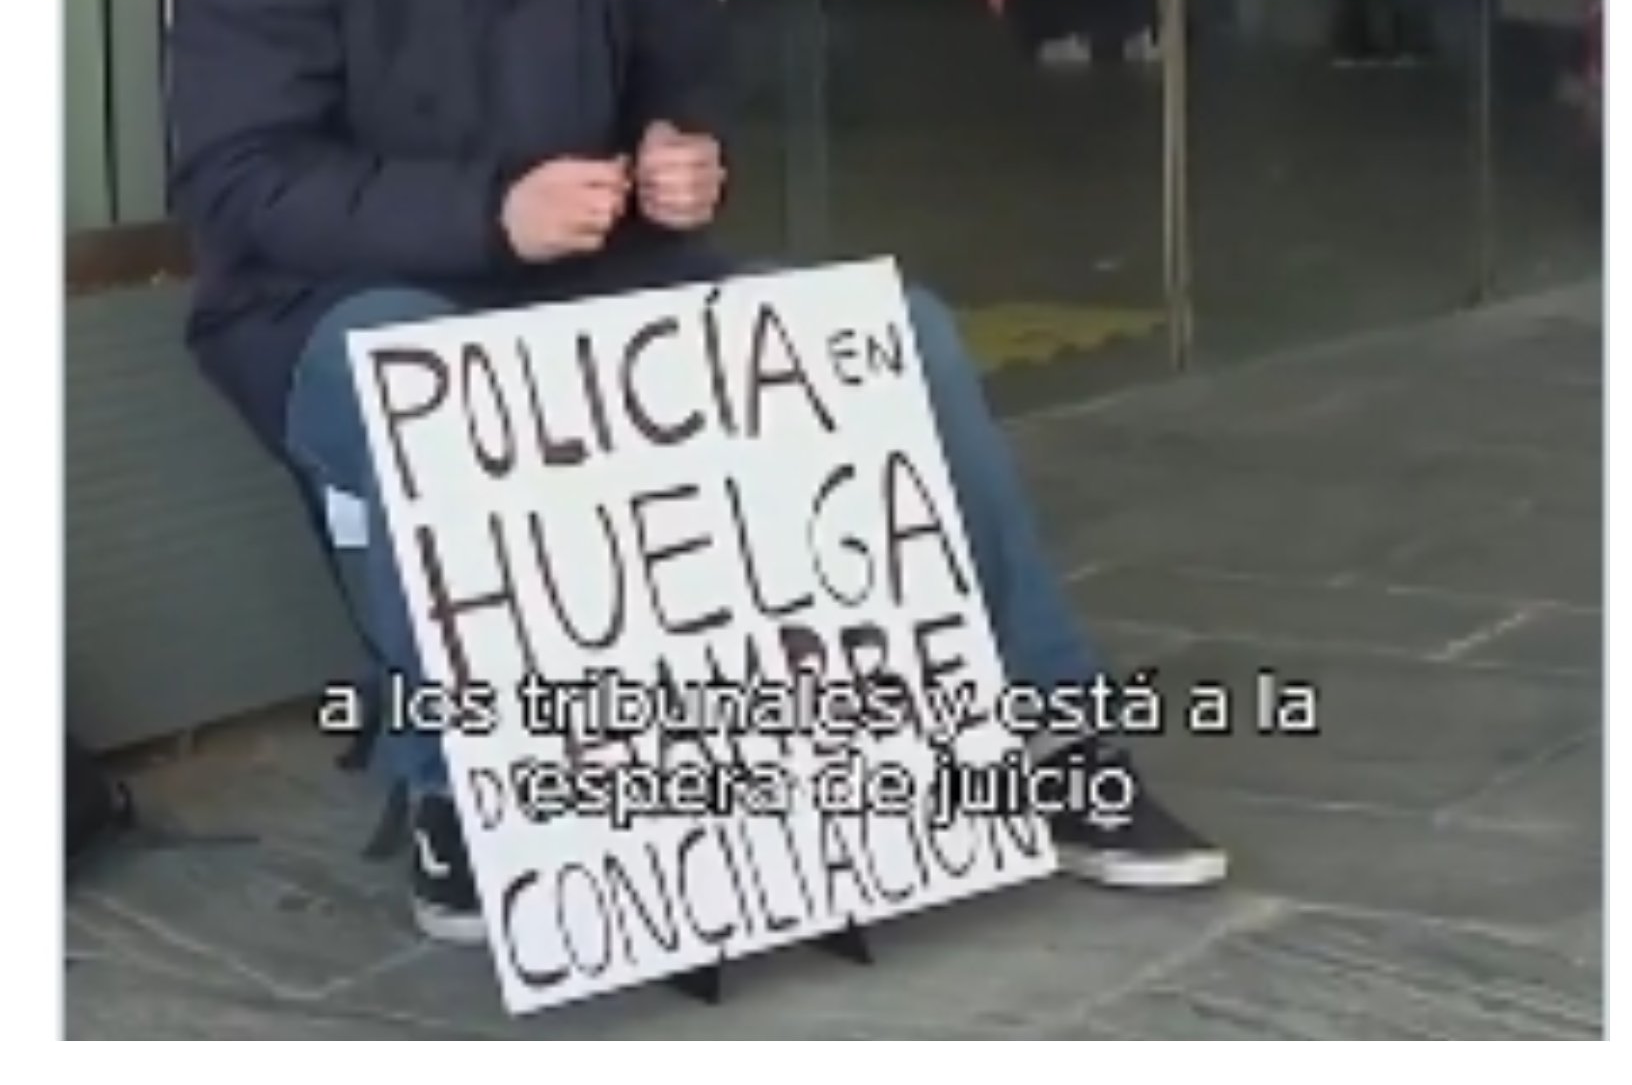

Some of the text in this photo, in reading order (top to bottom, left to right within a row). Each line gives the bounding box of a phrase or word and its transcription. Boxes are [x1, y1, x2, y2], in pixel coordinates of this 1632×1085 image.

[369, 287, 903, 499] POLICÍA EN
[412, 450, 970, 720] HUELGA
